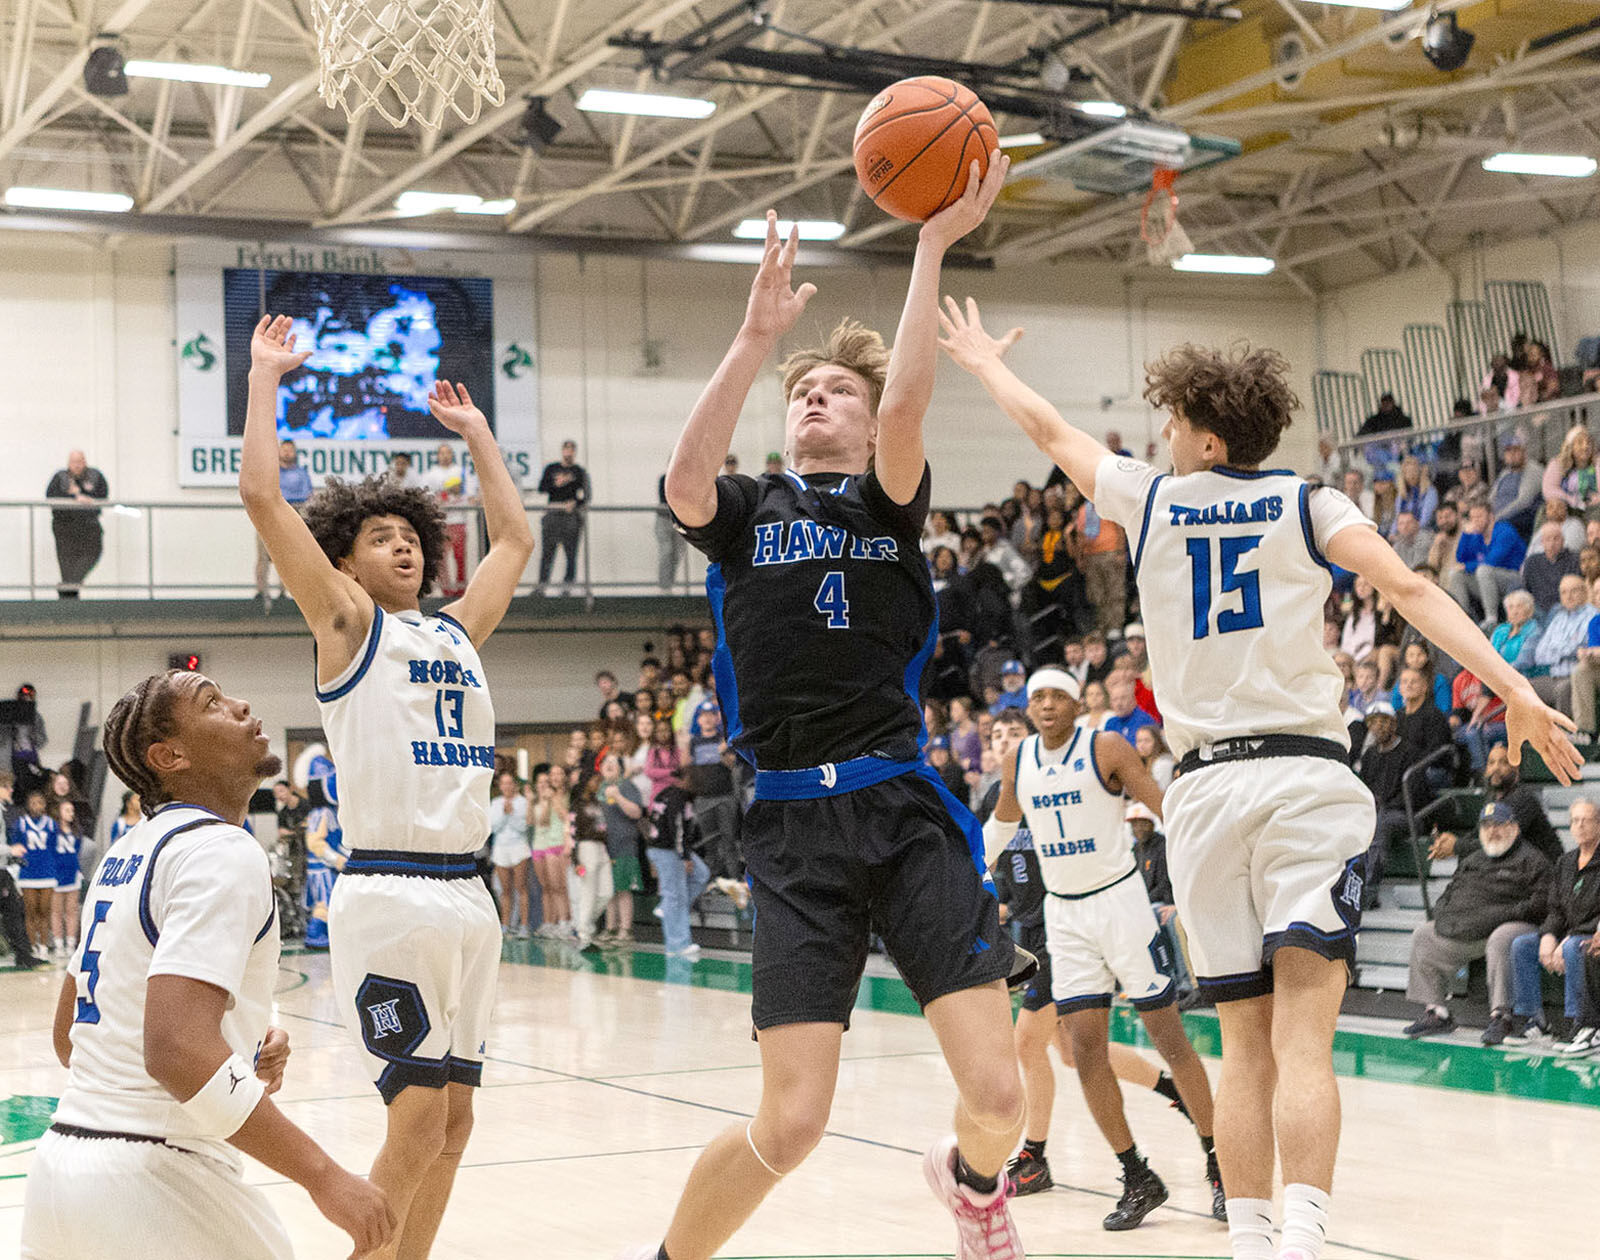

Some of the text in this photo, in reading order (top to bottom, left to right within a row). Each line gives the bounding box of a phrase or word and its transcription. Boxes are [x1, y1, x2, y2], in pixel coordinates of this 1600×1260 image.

[322, 250, 385, 274] Bank
[813, 571, 850, 629] 4
[1186, 534, 1265, 640] 15
[434, 689, 465, 739] 13
[1031, 790, 1082, 809] NORTH
[1055, 810, 1065, 839] 1
[26, 830, 48, 850] N
[56, 834, 77, 854] N
[1011, 853, 1029, 884] 2
[74, 900, 114, 1025] 5
